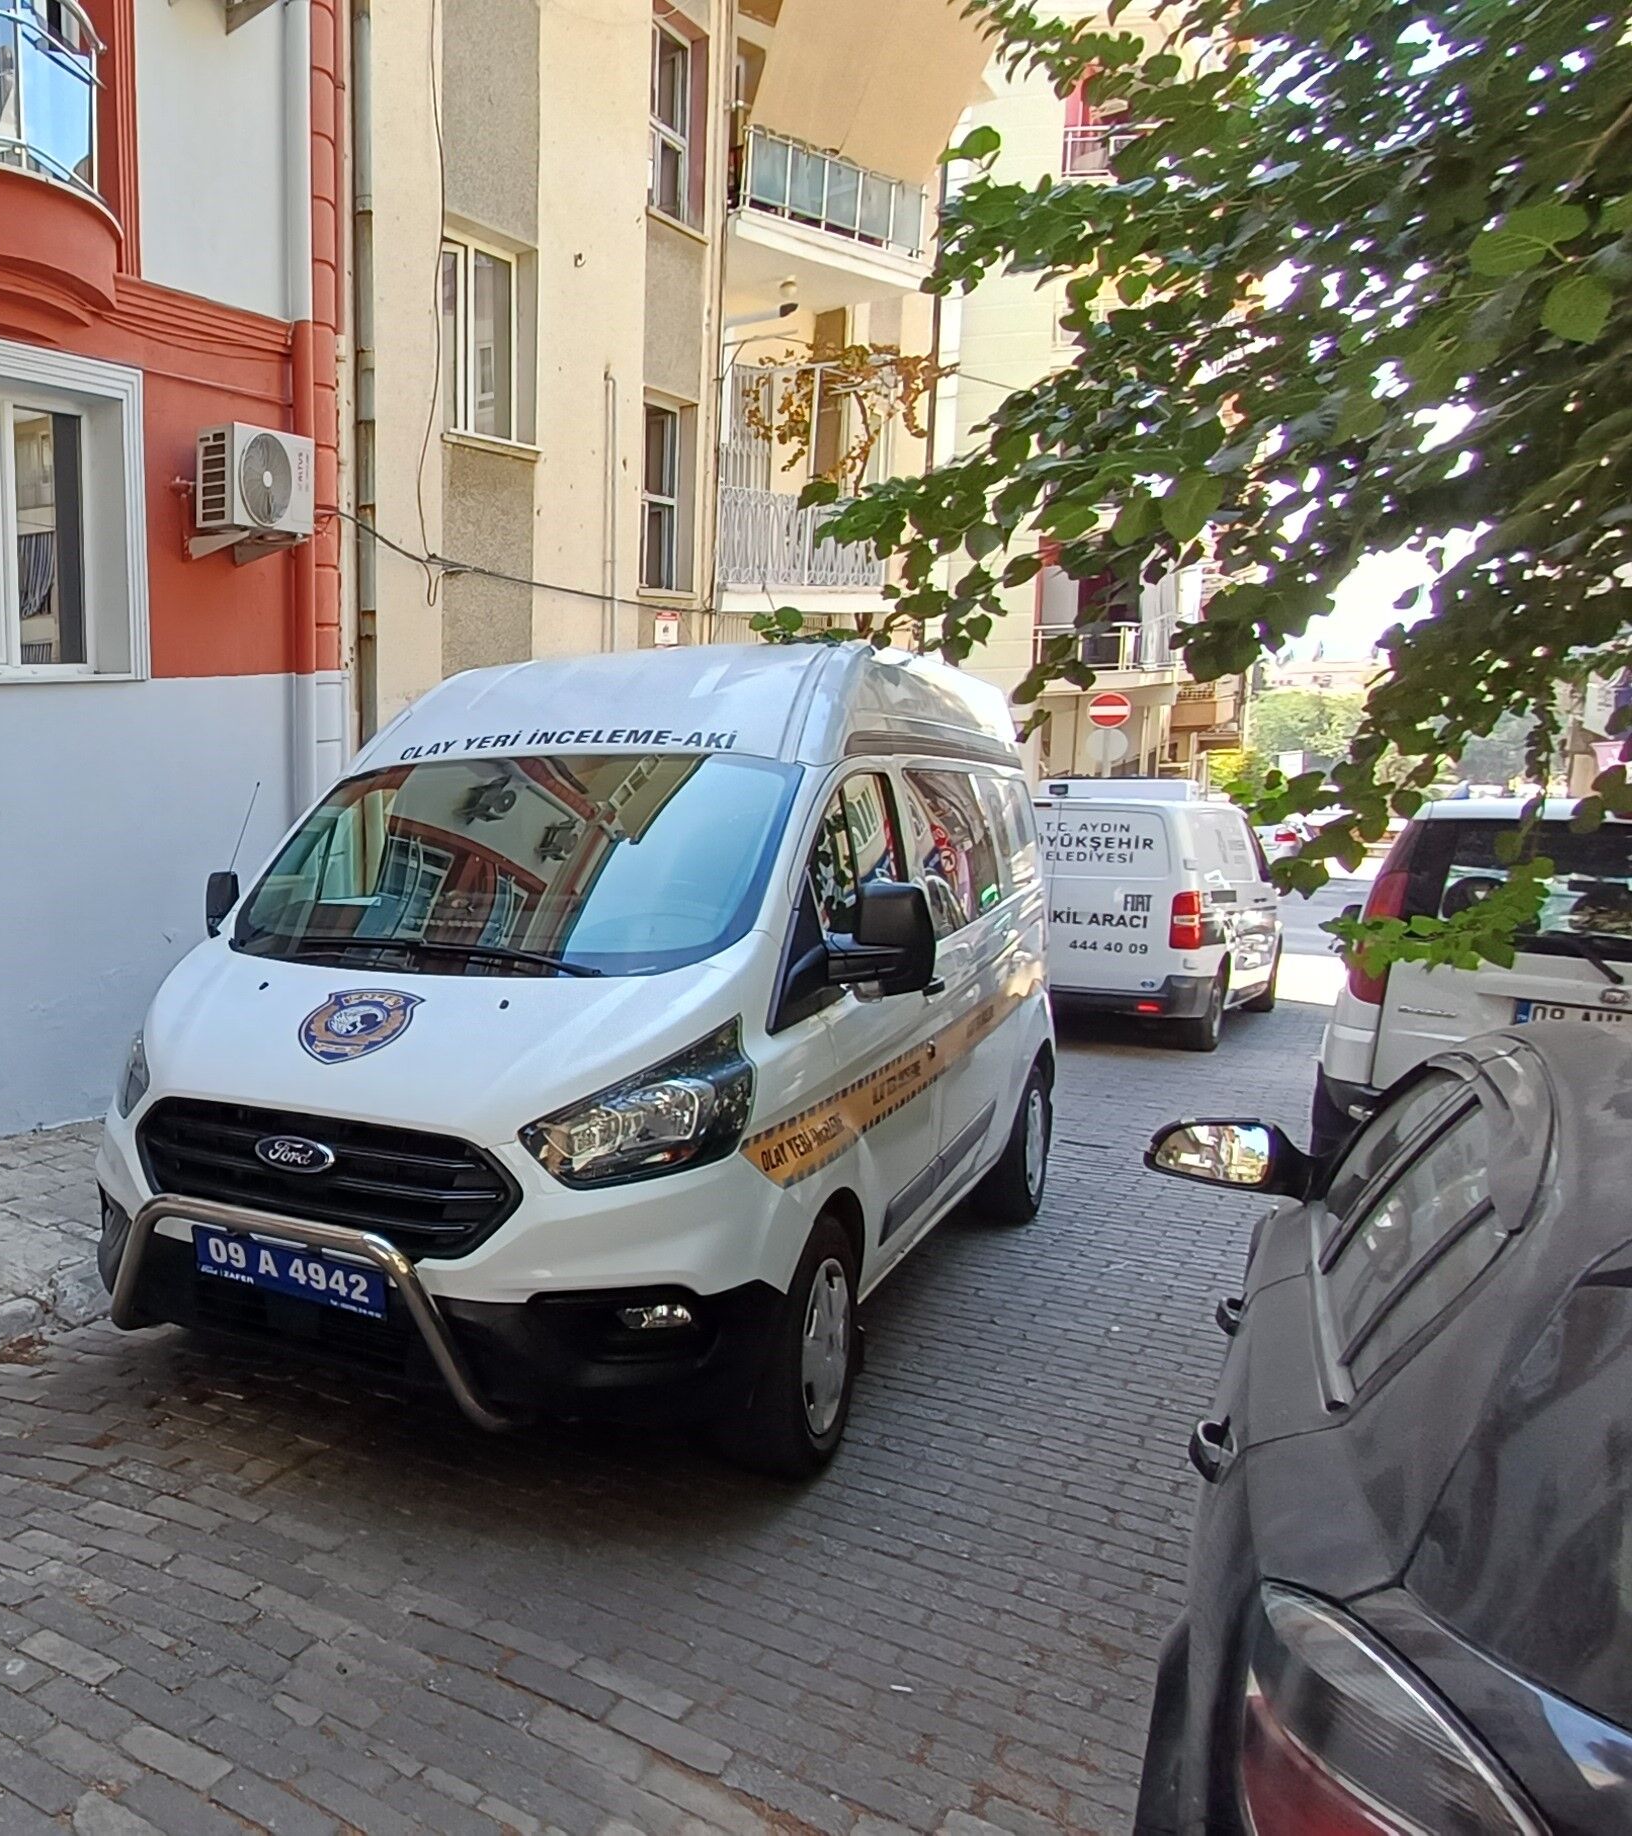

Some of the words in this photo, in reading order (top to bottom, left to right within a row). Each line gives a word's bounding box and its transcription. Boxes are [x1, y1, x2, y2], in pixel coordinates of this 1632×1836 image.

[399, 739, 457, 762] OLAY
[465, 730, 522, 751] YERİ
[525, 728, 738, 751] İNCELEME-AKİ
[1079, 822, 1130, 833] AYDIN
[1039, 832, 1154, 852] YÜKŞEHİR
[1045, 850, 1134, 864] ELEDİYESİ
[1123, 893, 1152, 912] FIAT
[1049, 906, 1083, 925] KİL
[1087, 912, 1148, 929] ARACI
[1069, 940, 1098, 951] 444
[1103, 942, 1123, 953] 40
[1128, 943, 1148, 954] 09
[269, 1140, 313, 1165] Ford
[208, 1237, 246, 1268] 09
[258, 1249, 279, 1278] A
[288, 1258, 370, 1303] 4942
